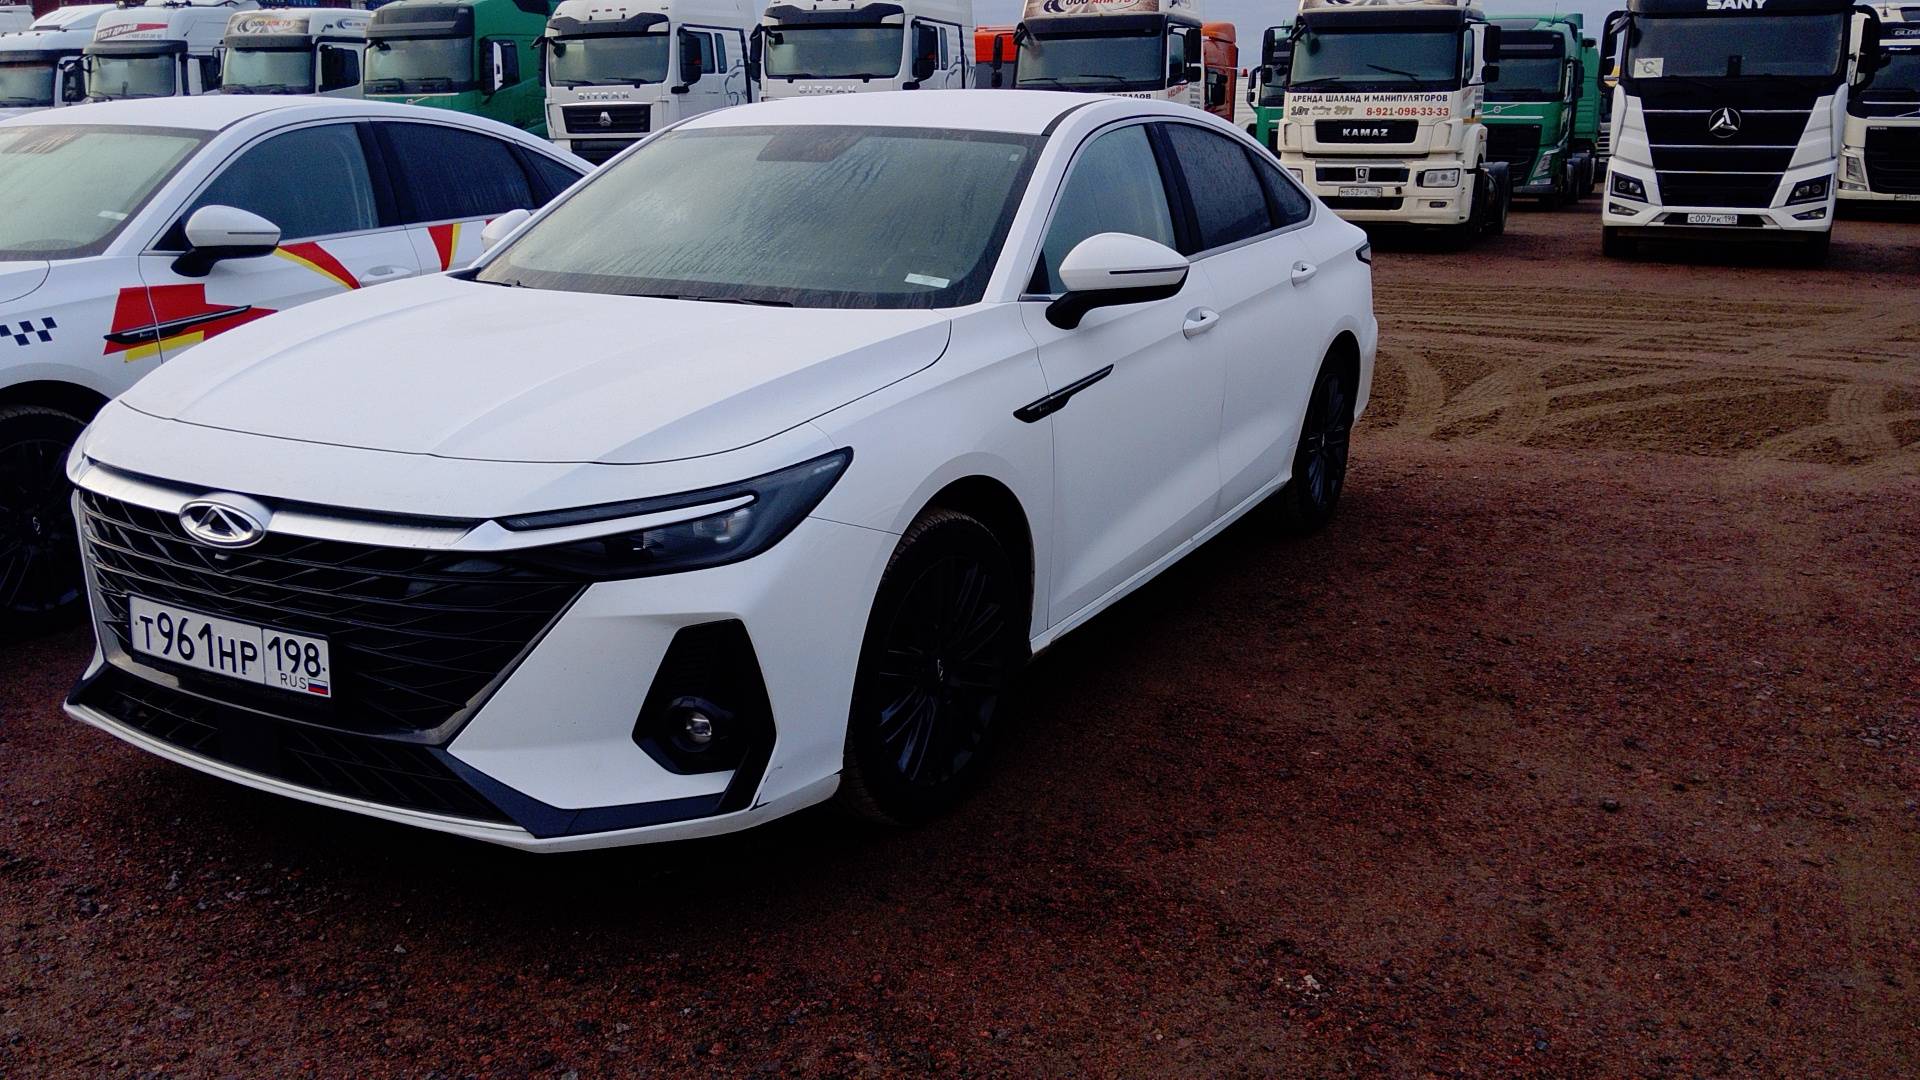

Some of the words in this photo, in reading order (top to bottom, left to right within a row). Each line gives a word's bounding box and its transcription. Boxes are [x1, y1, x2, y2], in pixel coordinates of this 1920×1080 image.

[1706, 0, 1767, 10] SANY
[798, 85, 857, 94] SITRAK
[577, 91, 630, 100] SITRAK
[1292, 95, 1323, 103] АРЕНДА
[1325, 95, 1361, 103] ШАЛАНД
[1372, 94, 1448, 102] МАНИПУЛЯТОРОВ
[1366, 107, 1449, 116] 8-921-098-33-33
[1342, 128, 1389, 137] KAMAZ
[139, 612, 258, 675] Т961НР
[268, 636, 321, 677] 198
[280, 673, 307, 689] RUS
